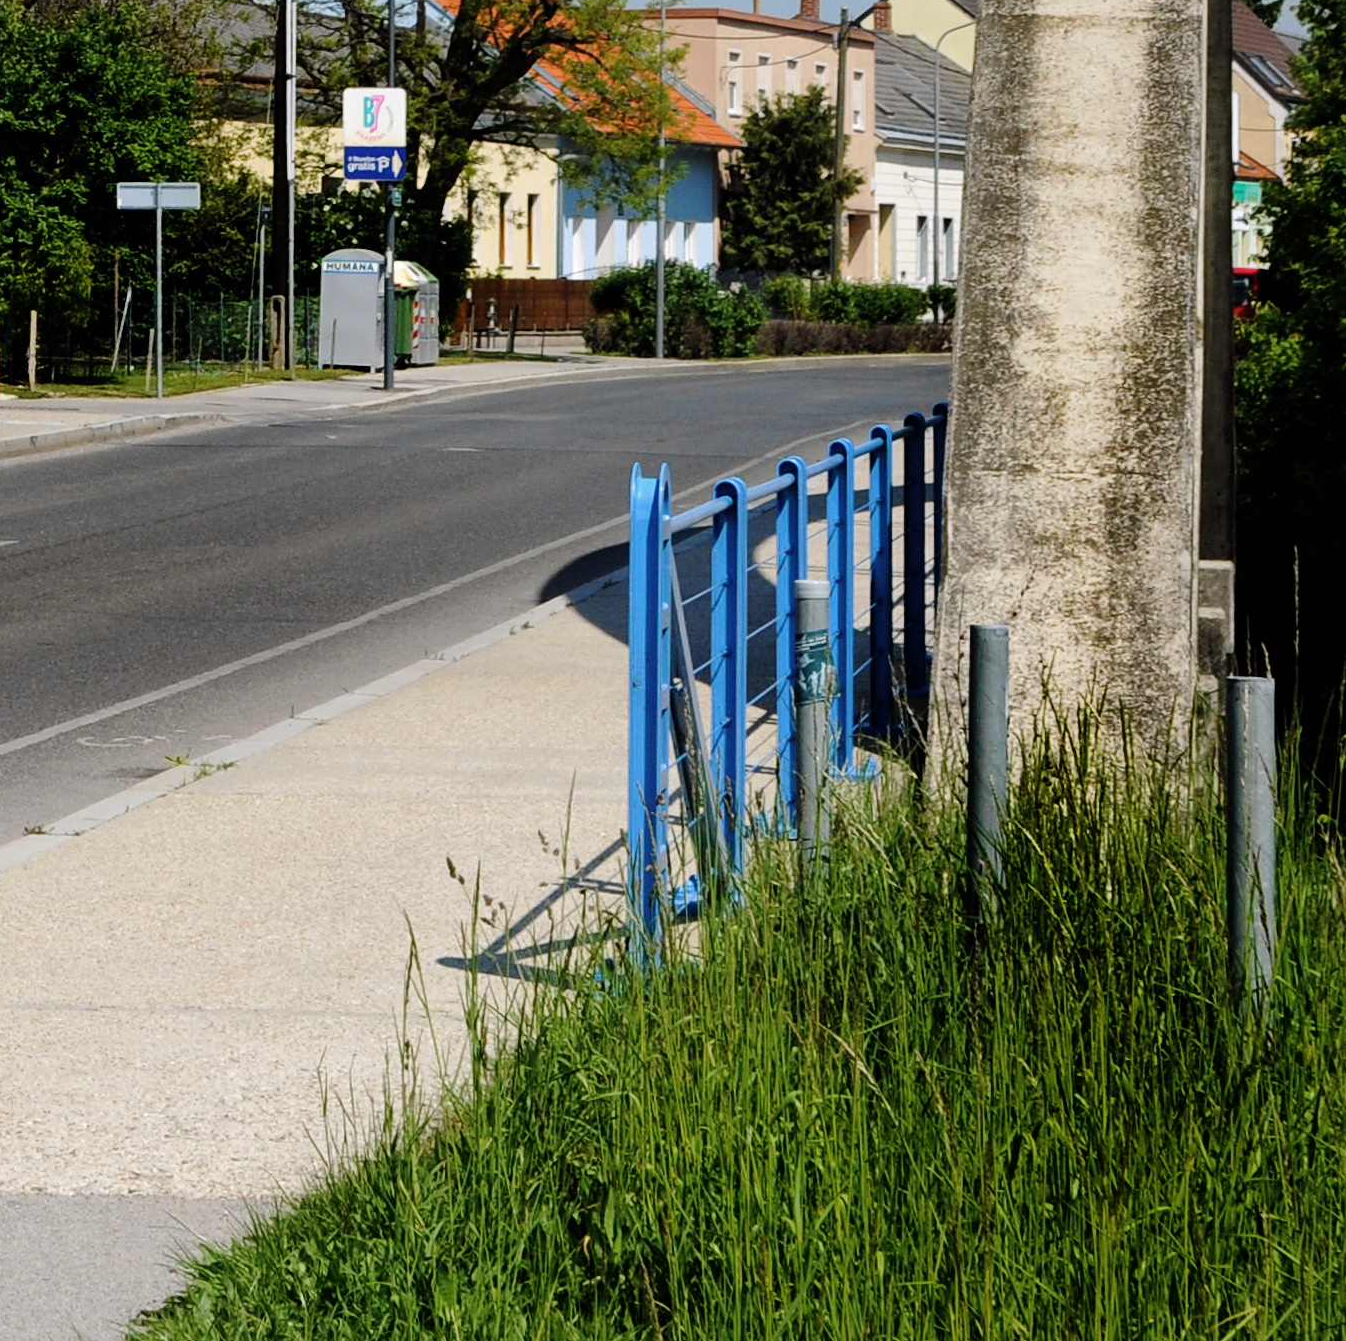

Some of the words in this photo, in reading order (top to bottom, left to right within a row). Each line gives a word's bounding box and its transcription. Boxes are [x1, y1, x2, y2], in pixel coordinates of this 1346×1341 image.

[363, 95, 385, 133] B7
[347, 162, 376, 172] gratis
[326, 262, 374, 271] HUMANA
